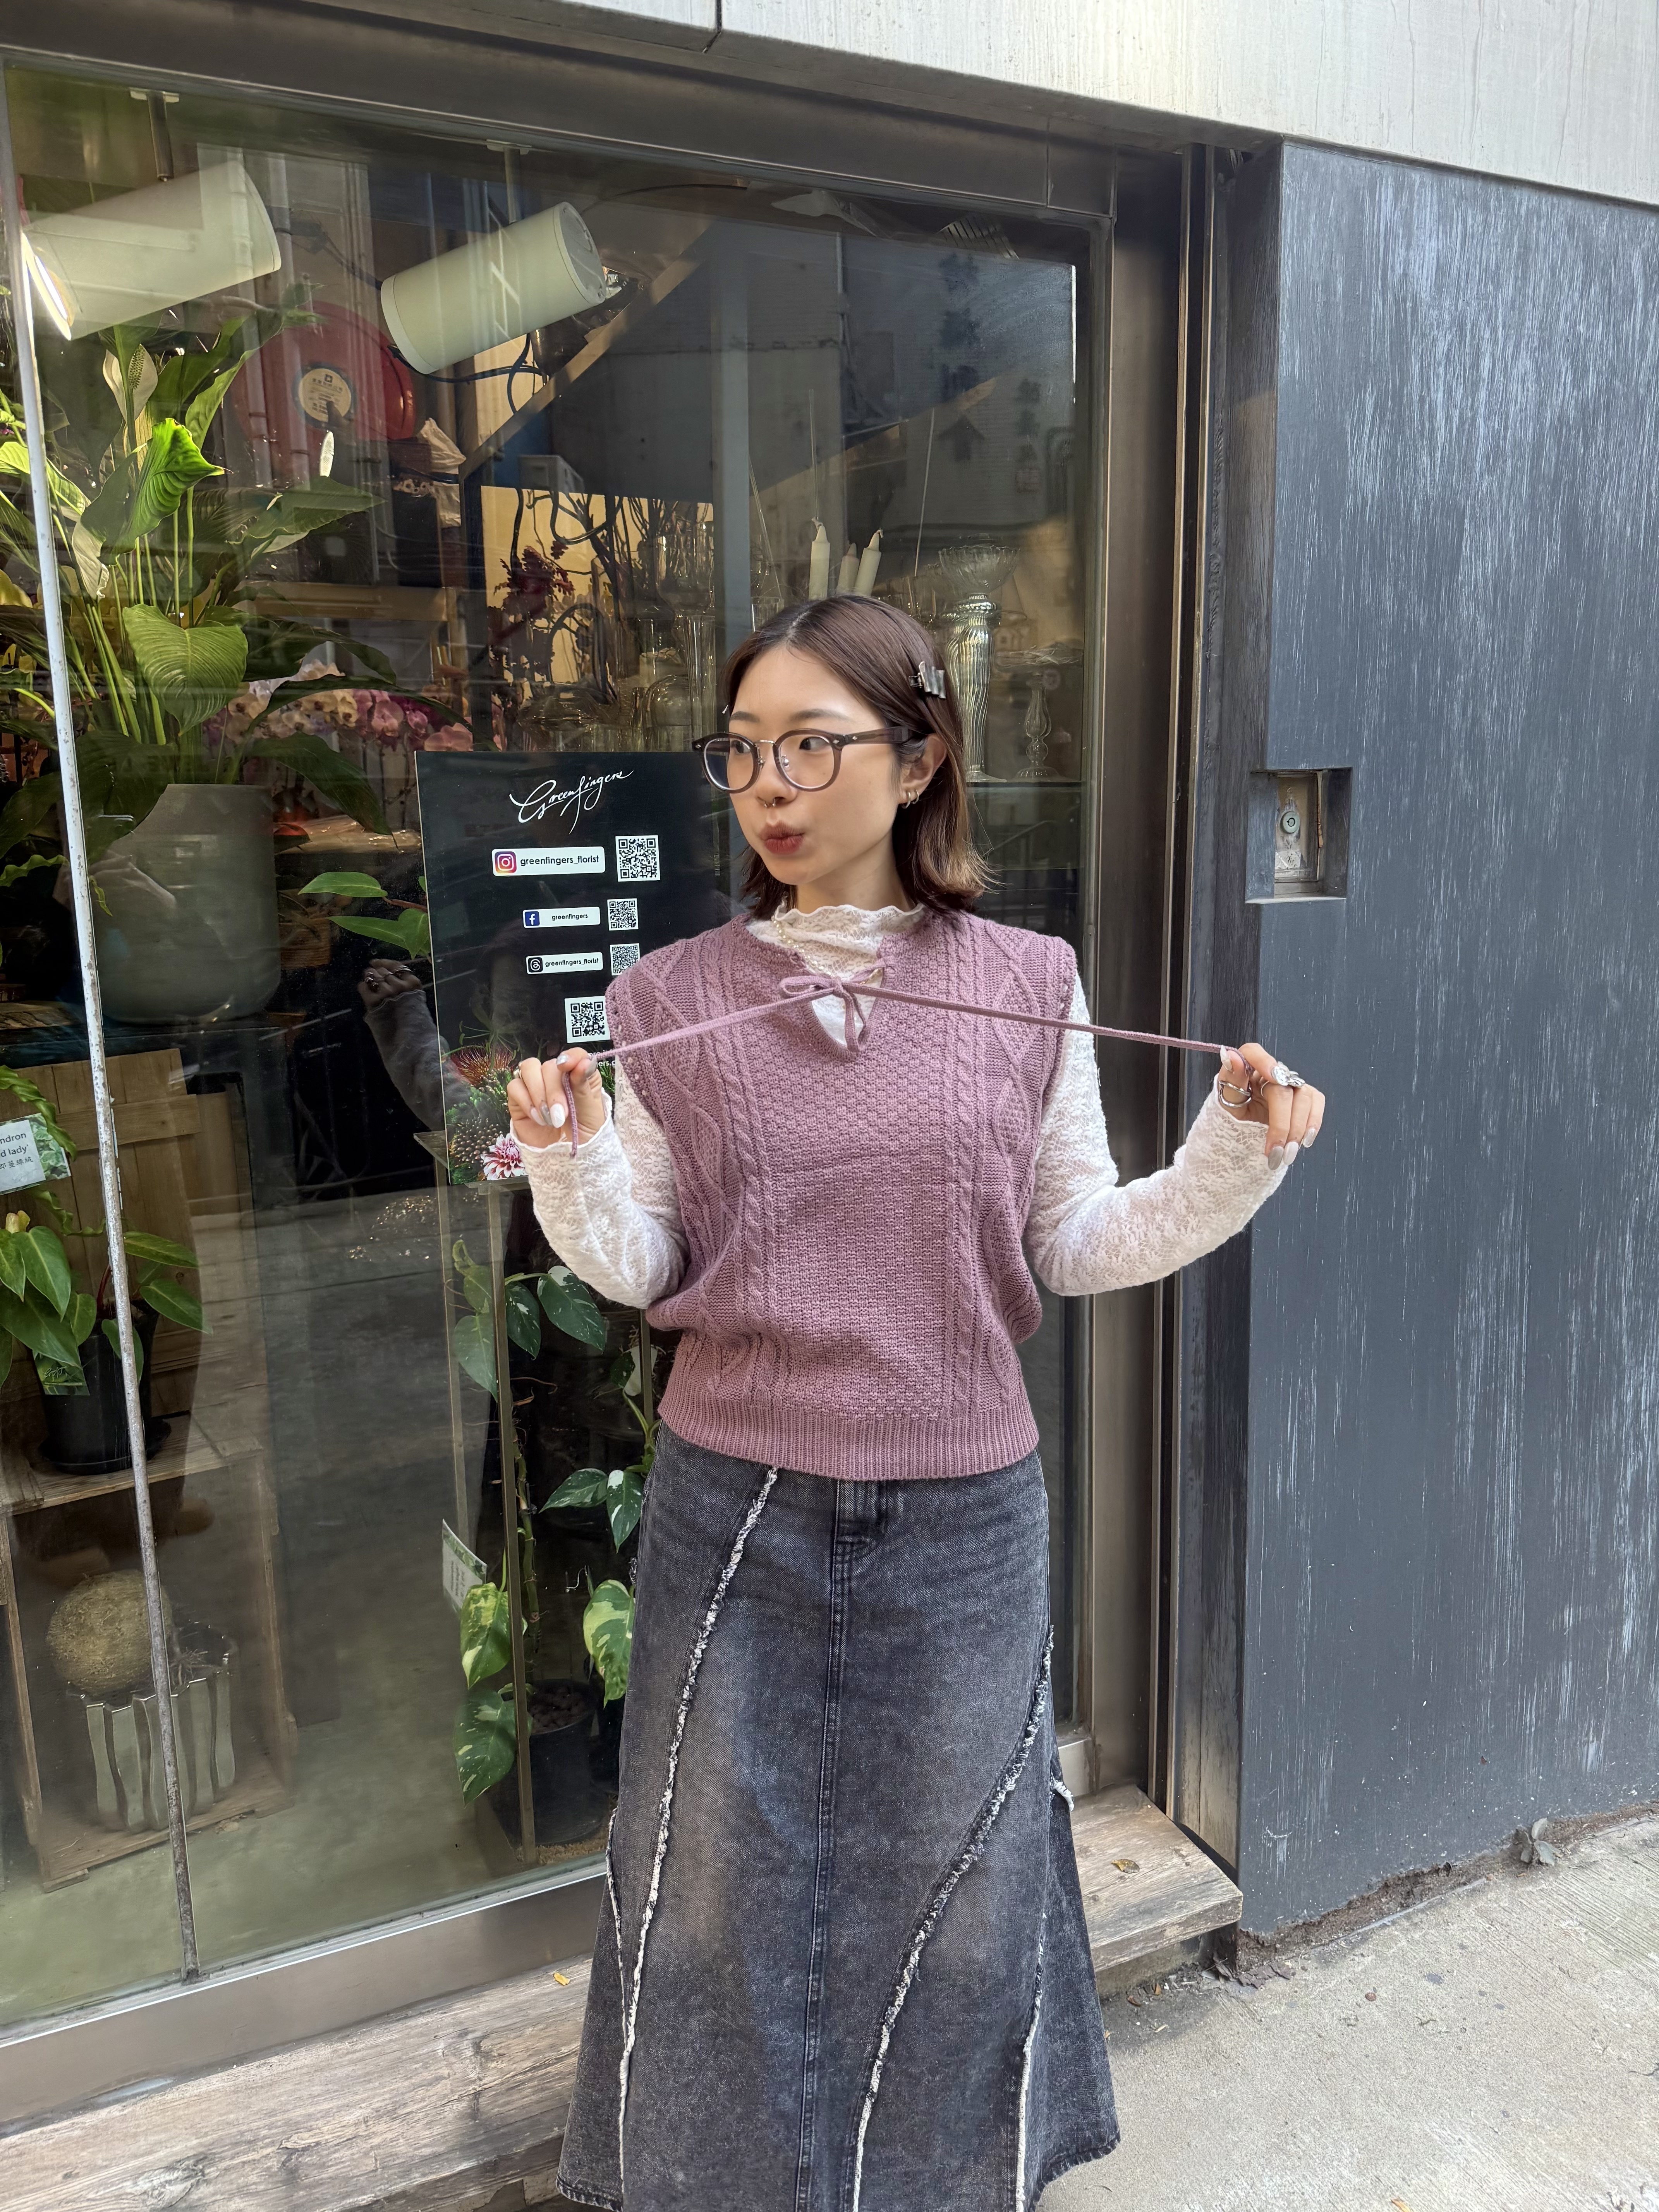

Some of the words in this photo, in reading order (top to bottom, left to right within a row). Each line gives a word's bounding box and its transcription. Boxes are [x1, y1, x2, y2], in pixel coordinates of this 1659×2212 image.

[509, 770, 634, 835] Greenfingers
[520, 855, 599, 866] greenfingers_florist
[545, 958, 599, 967] greenfingers_florist
